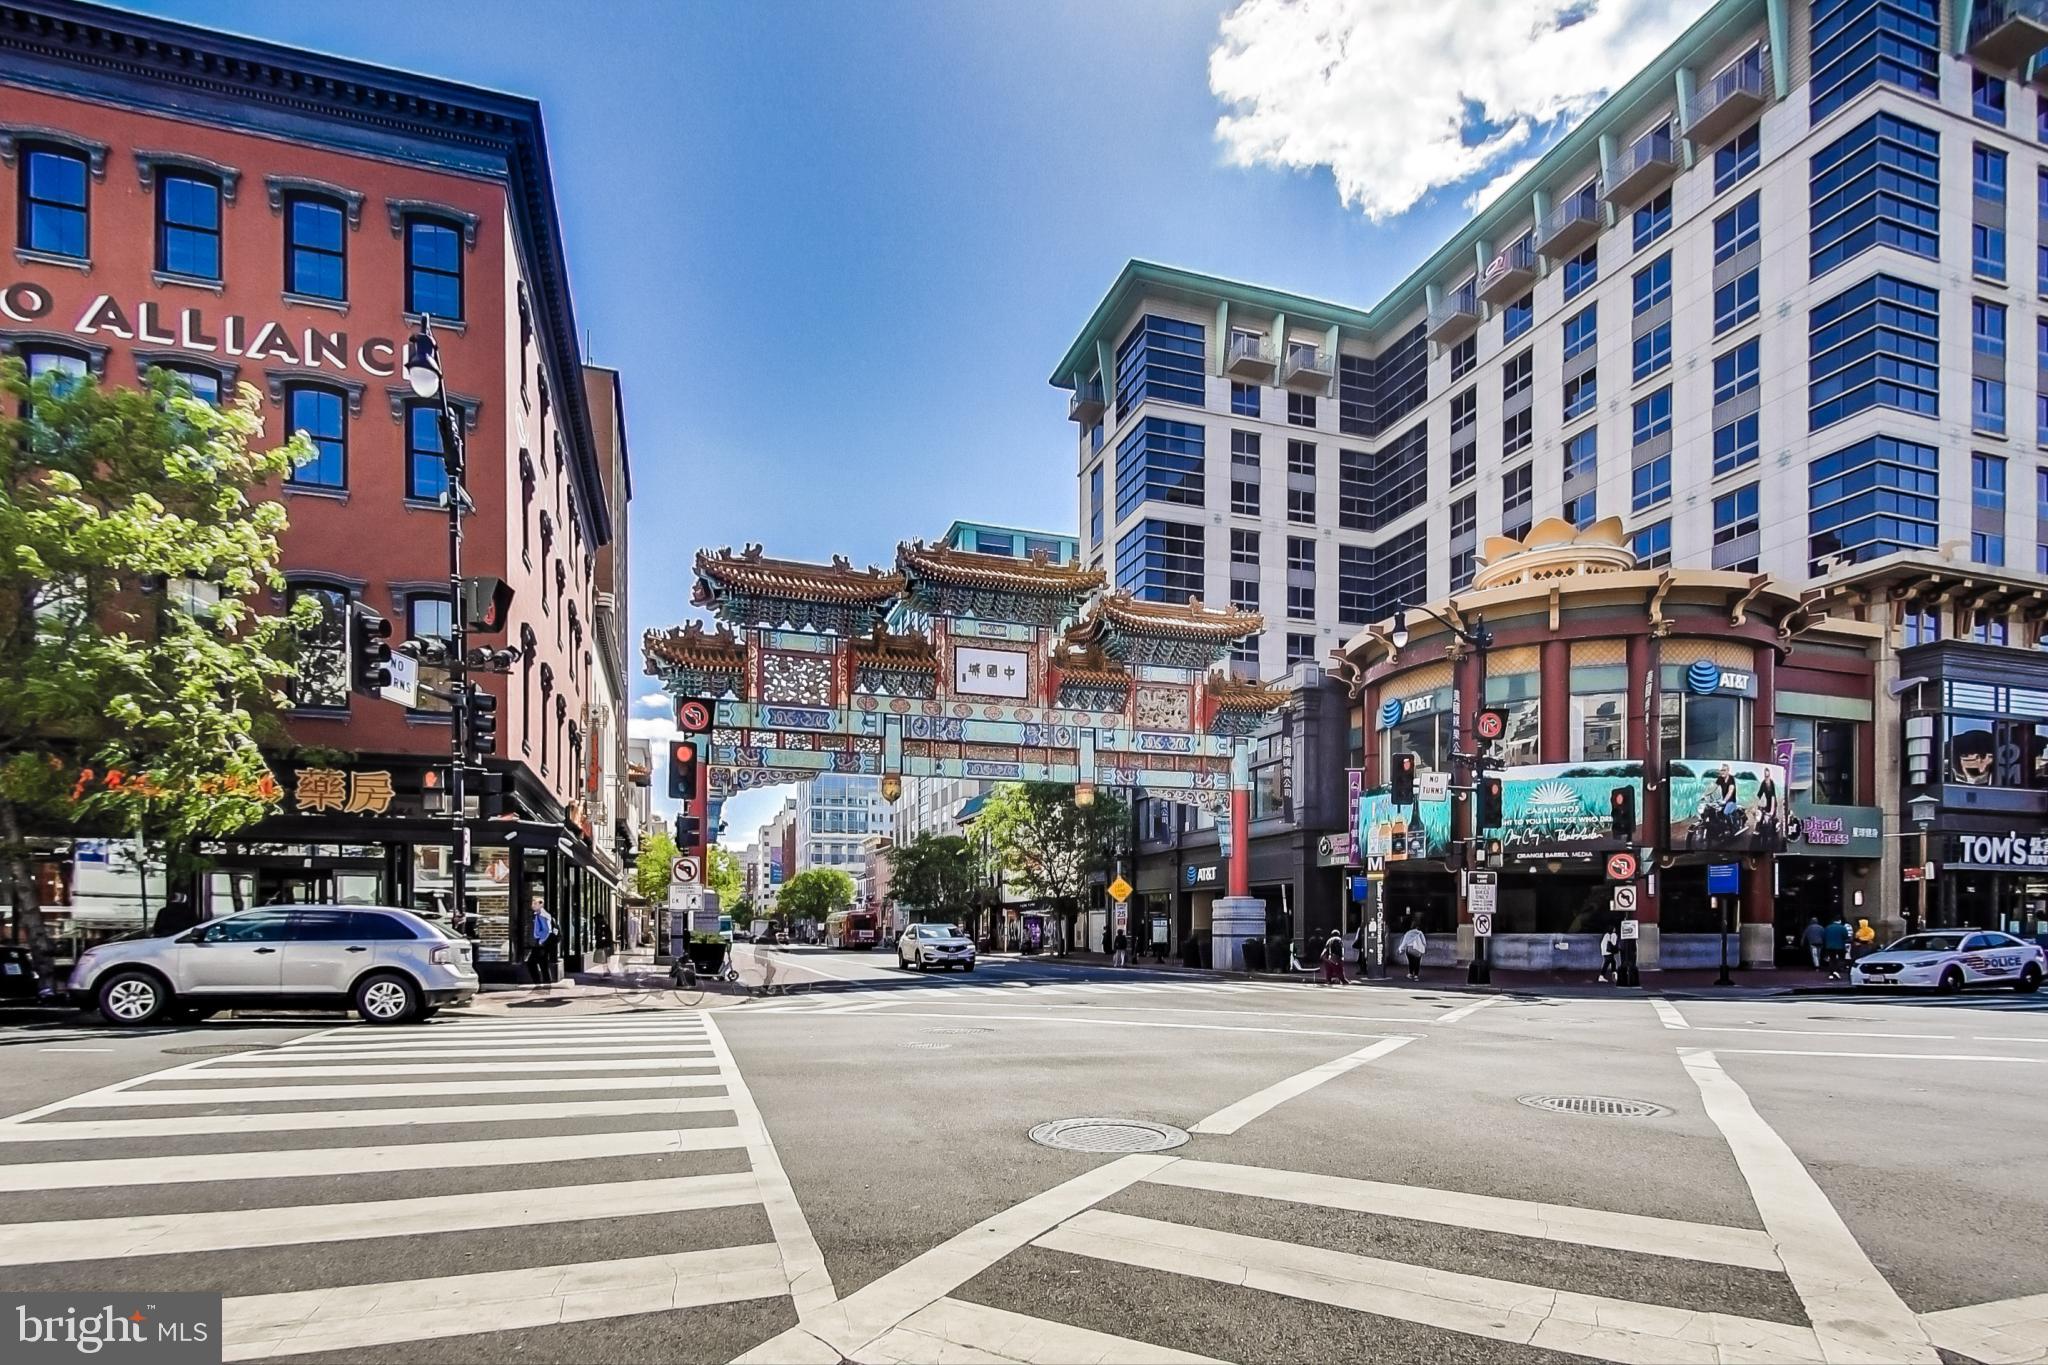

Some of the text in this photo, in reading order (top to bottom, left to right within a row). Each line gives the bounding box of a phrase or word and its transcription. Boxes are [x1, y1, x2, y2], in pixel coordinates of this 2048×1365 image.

[1720, 672, 1750, 690] AT&T
[1403, 694, 1434, 717] AT&T
[1429, 775, 1439, 784] NO
[294, 766, 396, 814] 藥房
[1422, 786, 1444, 795] TURNS
[1526, 805, 1580, 815] CASAMIGOS
[1553, 816, 1577, 825] THOSE
[1571, 850, 1593, 858] MEDIA
[1960, 830, 2027, 865] TOM'S
[1367, 856, 1383, 871] M
[1197, 866, 1217, 882] AT&T
[1117, 910, 1126, 918] 25
[1984, 956, 2023, 969] POLICE
